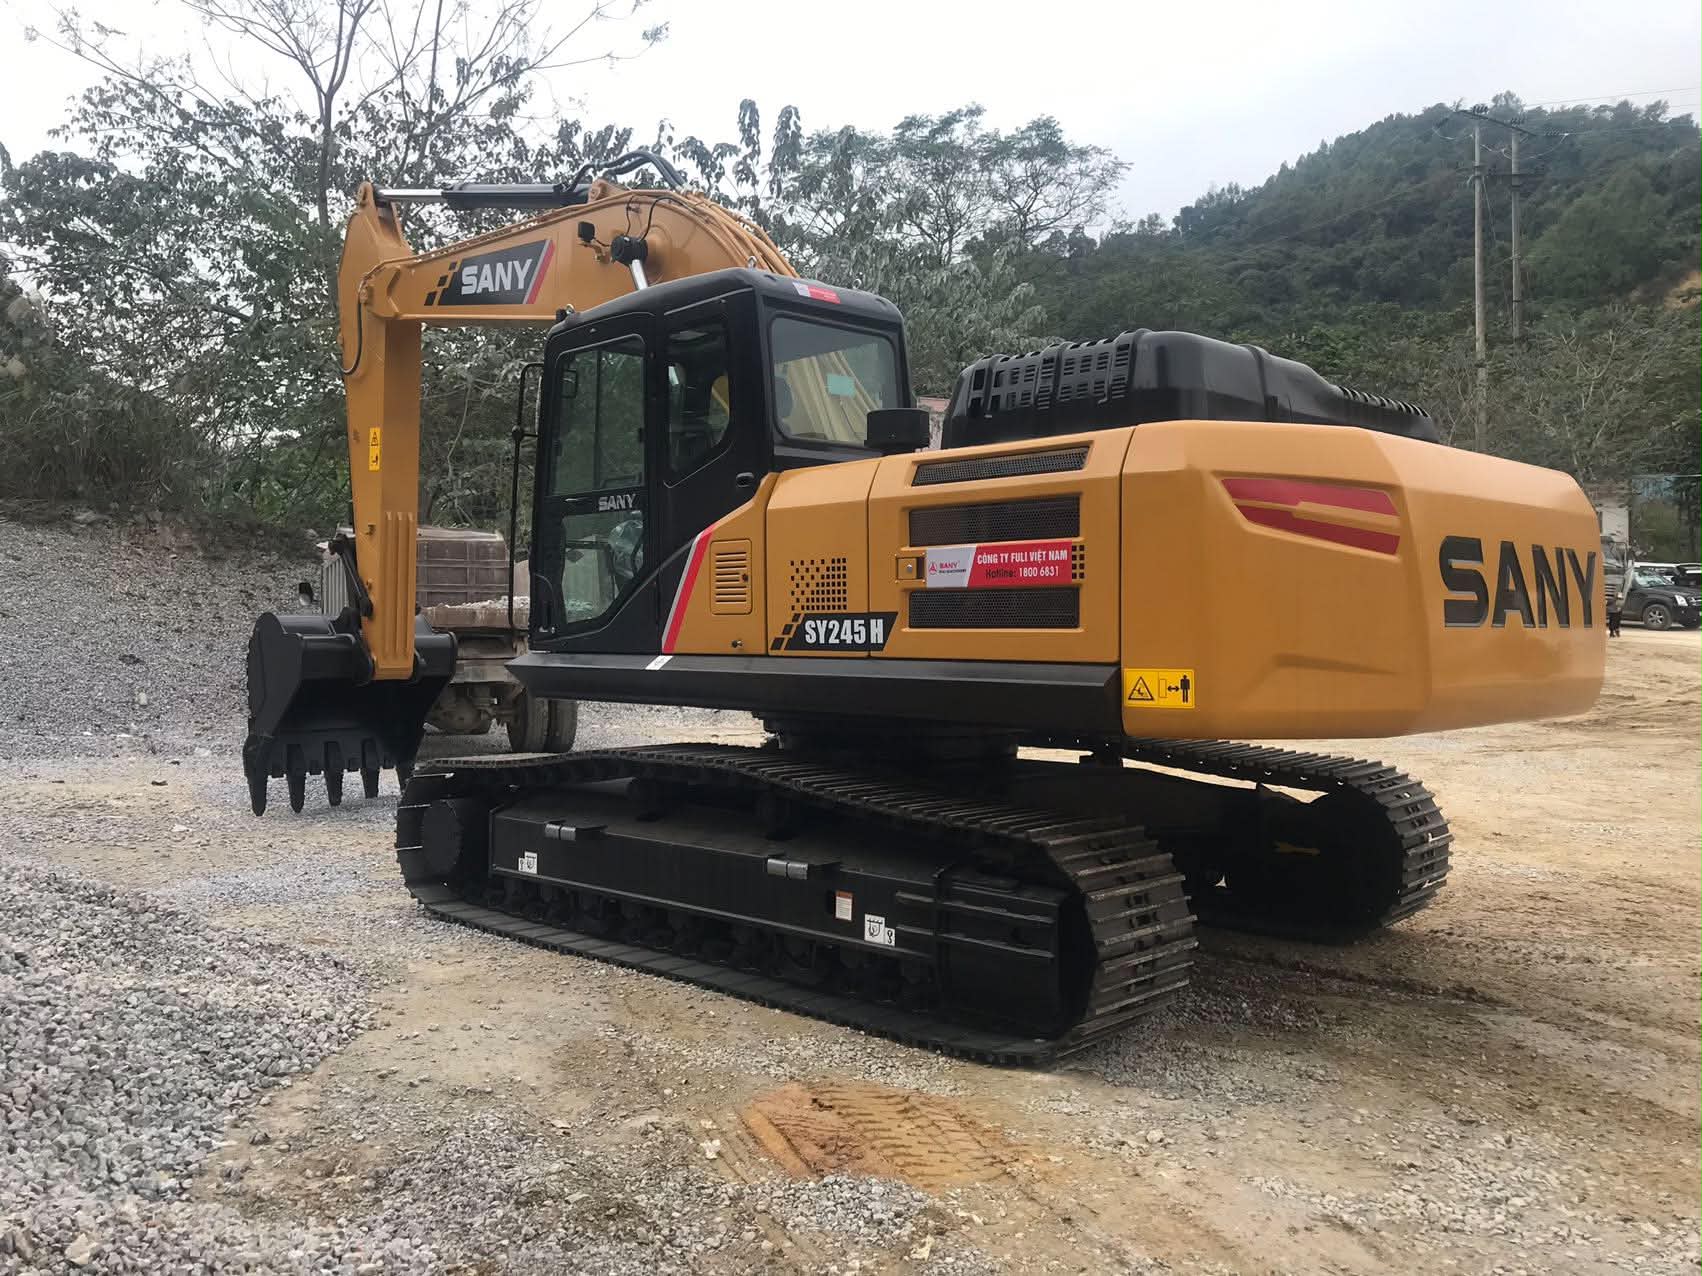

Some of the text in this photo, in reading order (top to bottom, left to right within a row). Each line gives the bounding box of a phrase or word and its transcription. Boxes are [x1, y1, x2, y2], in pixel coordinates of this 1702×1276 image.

[461, 258, 533, 296] SANY
[598, 493, 637, 511] SANY
[977, 549, 1068, 565] CÔNG TY FULI VIỆT NAM
[1019, 566, 1038, 577] 1800
[1039, 565, 1059, 577] 6831
[1439, 535, 1597, 629] SANY
[804, 618, 884, 644] SY245 H
